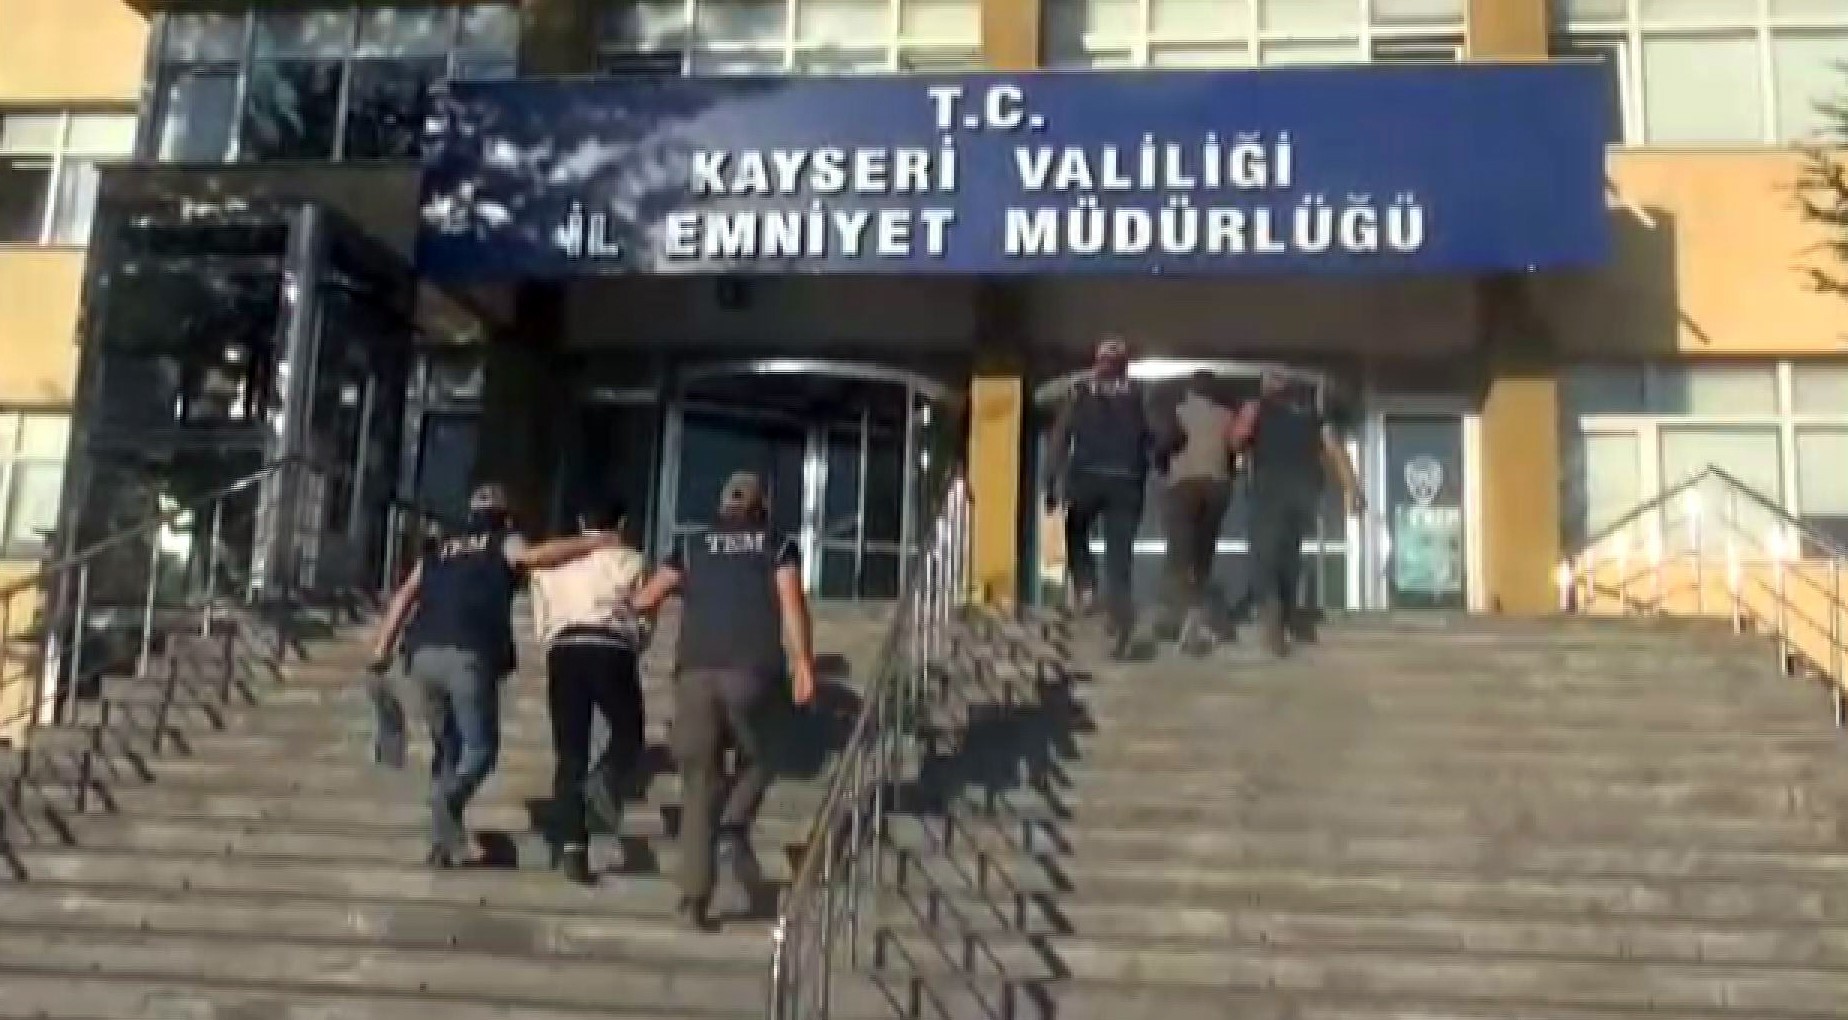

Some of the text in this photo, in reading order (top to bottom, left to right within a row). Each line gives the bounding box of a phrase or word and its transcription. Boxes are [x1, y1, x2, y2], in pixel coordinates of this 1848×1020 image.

[929, 85, 1046, 129] T.C.
[690, 130, 1294, 194] KAYSERİ VALİLİĞİ
[566, 193, 1424, 258] İL EMNİYET MÜDÜRLÜĞÜ
[704, 532, 765, 554] TEM
